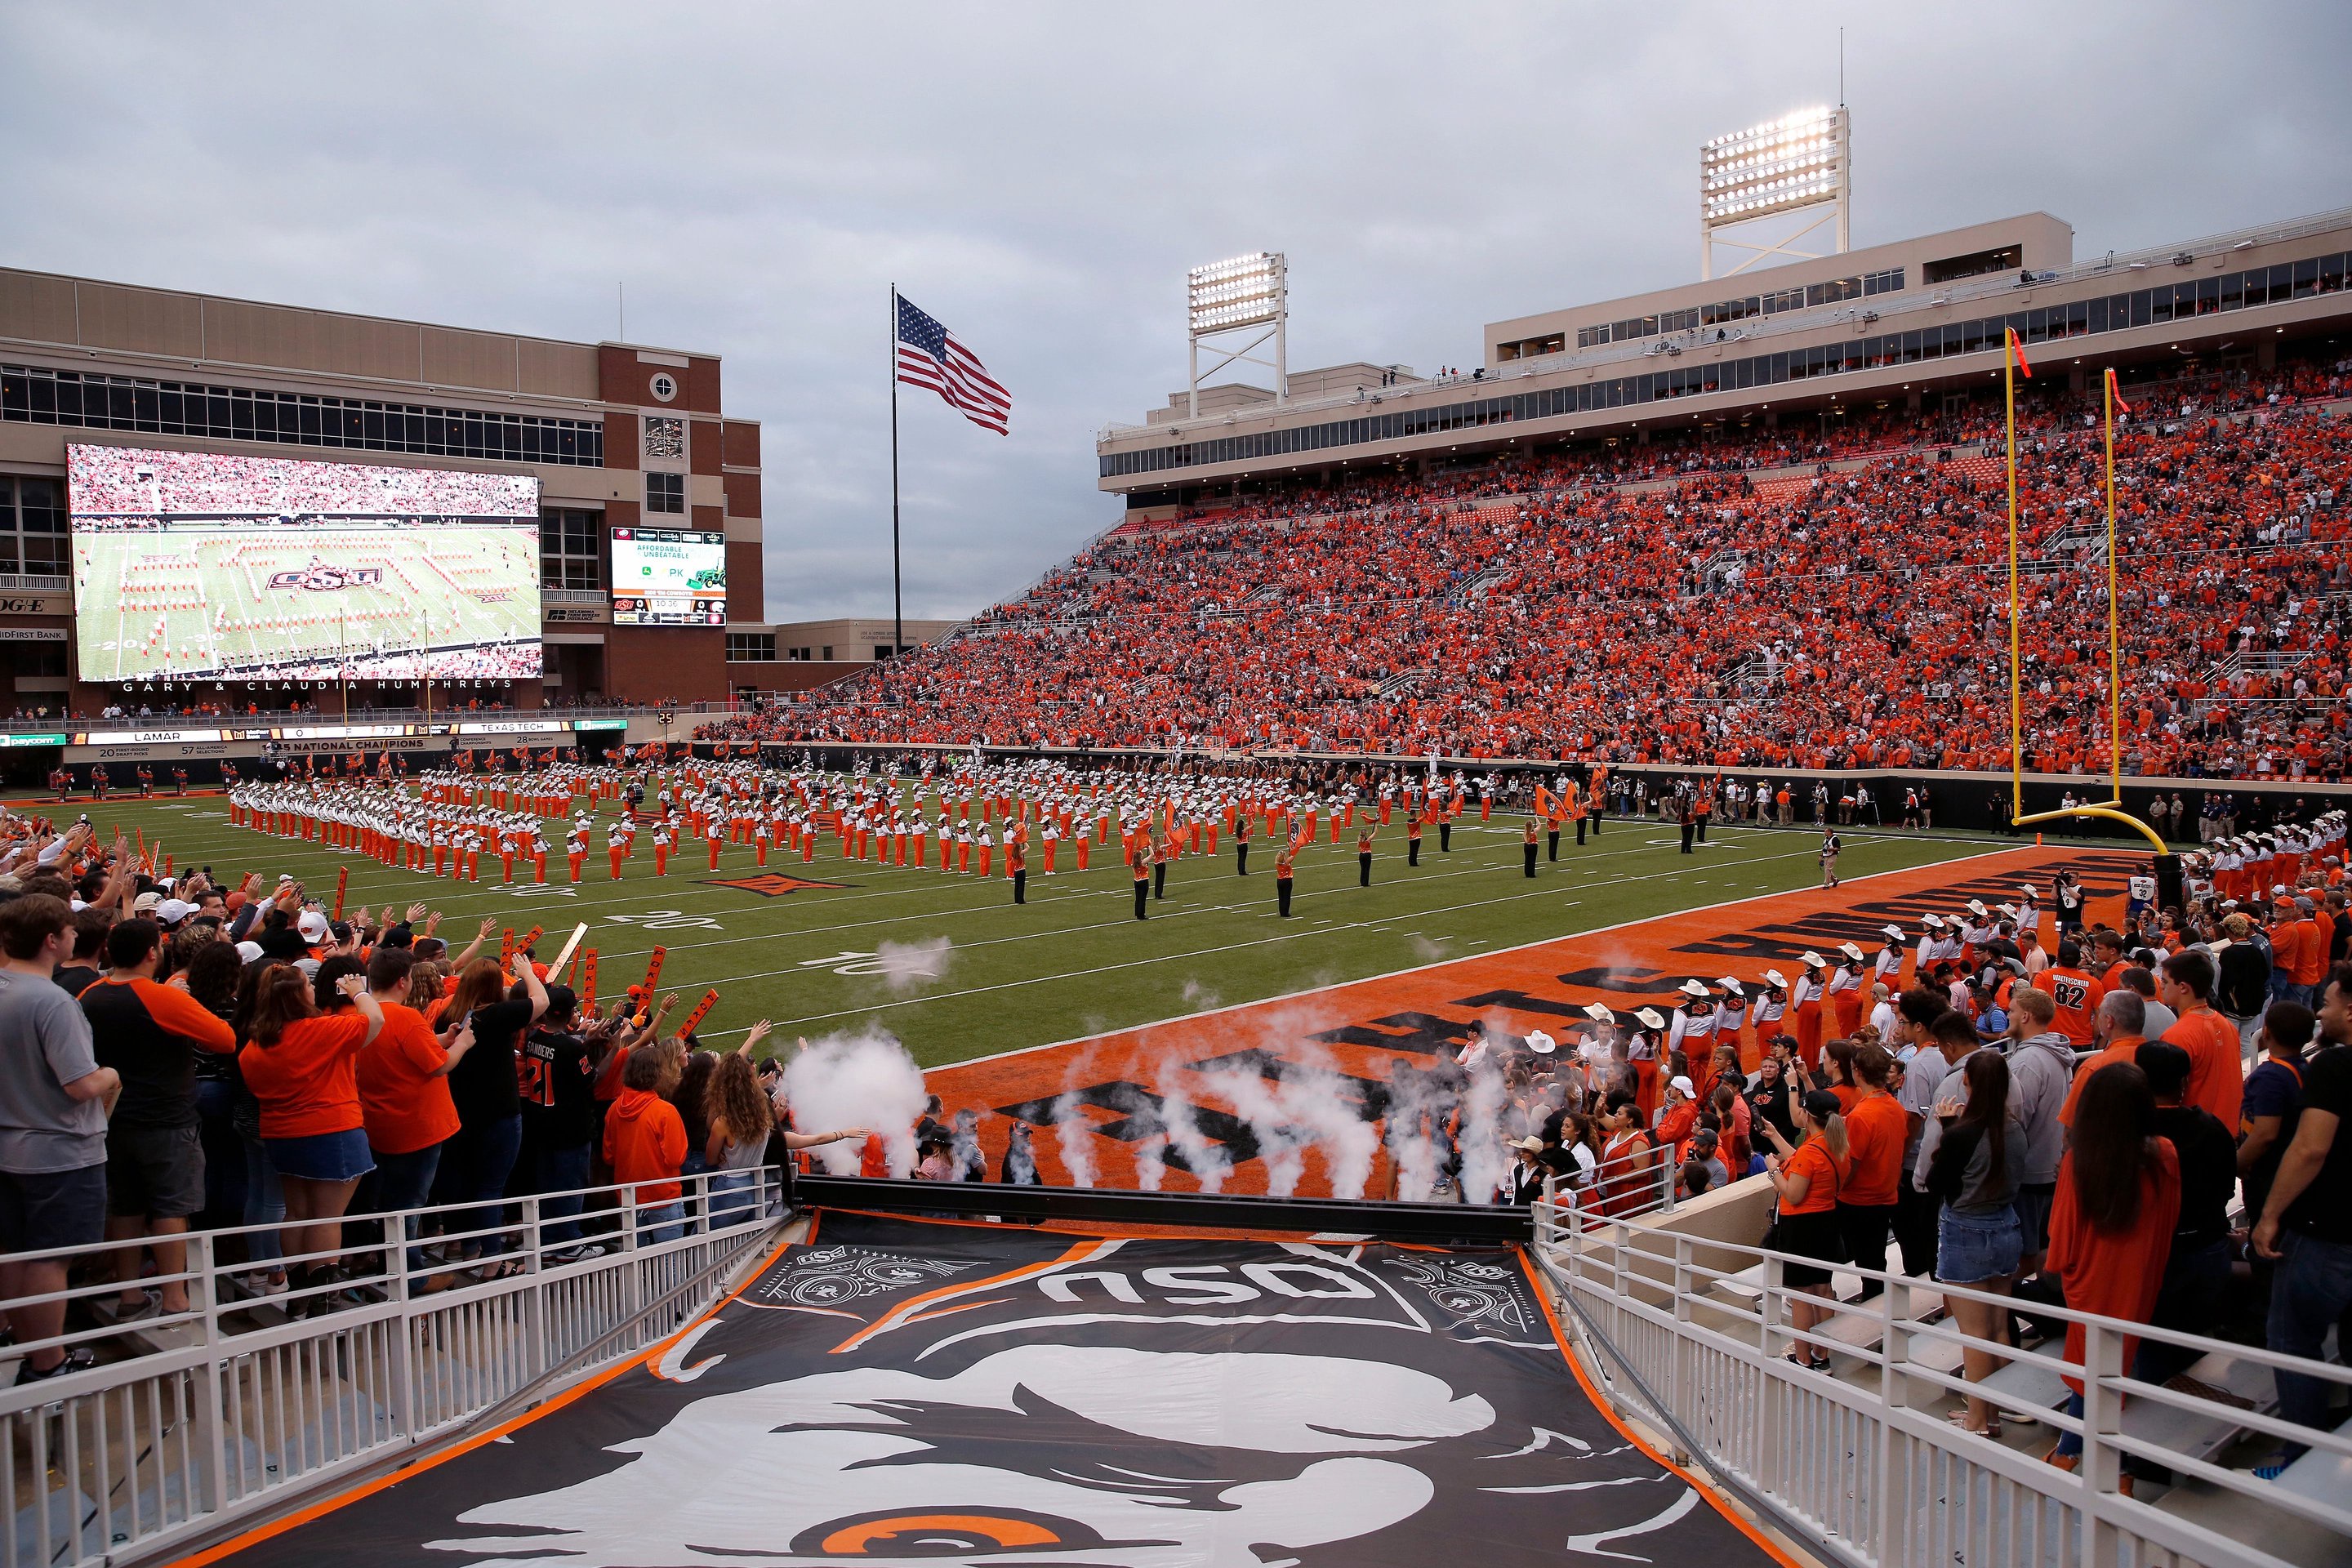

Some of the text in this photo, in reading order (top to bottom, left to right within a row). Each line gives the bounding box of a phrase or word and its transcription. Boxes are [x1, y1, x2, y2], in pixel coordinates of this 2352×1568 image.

[100, 639, 138, 651] 20
[122, 680, 511, 692] GARY & CLAUDIA HUMPHREYS
[658, 713, 673, 724] 25
[11, 737, 55, 746] paycom
[135, 733, 180, 742] LAMAR
[181, 746, 194, 755] 57
[294, 742, 354, 751] NATIONAL
[356, 740, 424, 750] CHAMPIONS
[100, 748, 114, 757] 20
[2139, 889, 2147, 898] 32
[603, 910, 716, 929] 20
[500, 930, 512, 968] POKE
[584, 952, 595, 1004] POKES
[640, 950, 663, 1000] POKES
[2052, 974, 2090, 987] WALTERSCHEID
[2054, 982, 2087, 1010] 82
[681, 994, 715, 1036] POKES
[526, 1040, 555, 1060] SANDERS
[527, 1057, 555, 1107] 21
[1036, 1263, 1377, 1305] OSU
